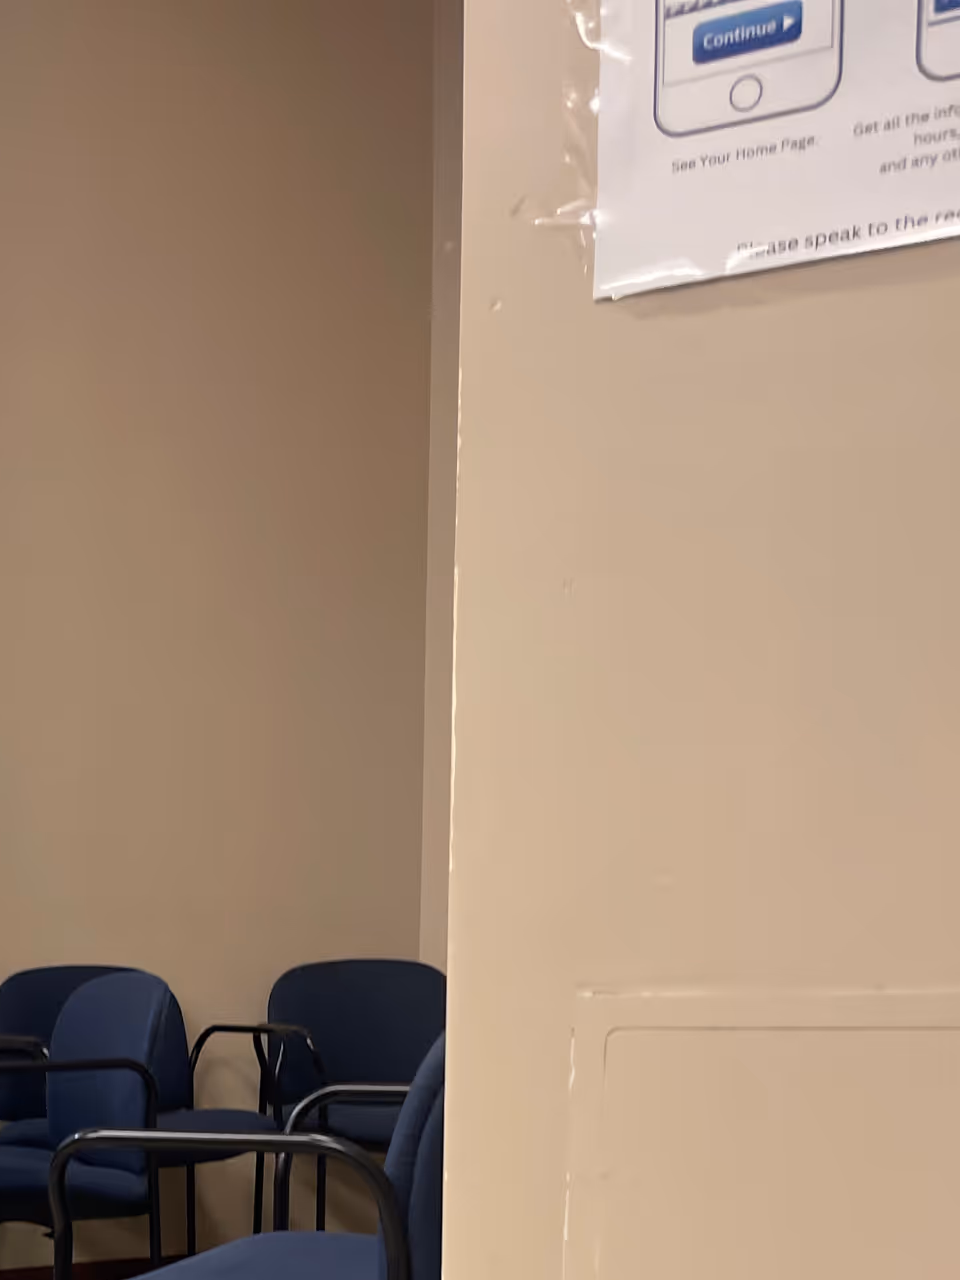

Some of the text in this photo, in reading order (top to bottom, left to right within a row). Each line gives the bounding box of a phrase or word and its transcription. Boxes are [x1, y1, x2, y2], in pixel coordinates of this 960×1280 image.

[702, 20, 777, 50] Continue
[852, 121, 879, 137] Get
[883, 116, 900, 132] all
[905, 112, 930, 128] the
[672, 158, 696, 175] See
[699, 151, 731, 168] Your
[736, 142, 778, 161] Home
[879, 157, 908, 174] and
[911, 152, 938, 169] any
[804, 224, 862, 252] speak
[868, 219, 888, 237] to
[895, 214, 929, 232] the
